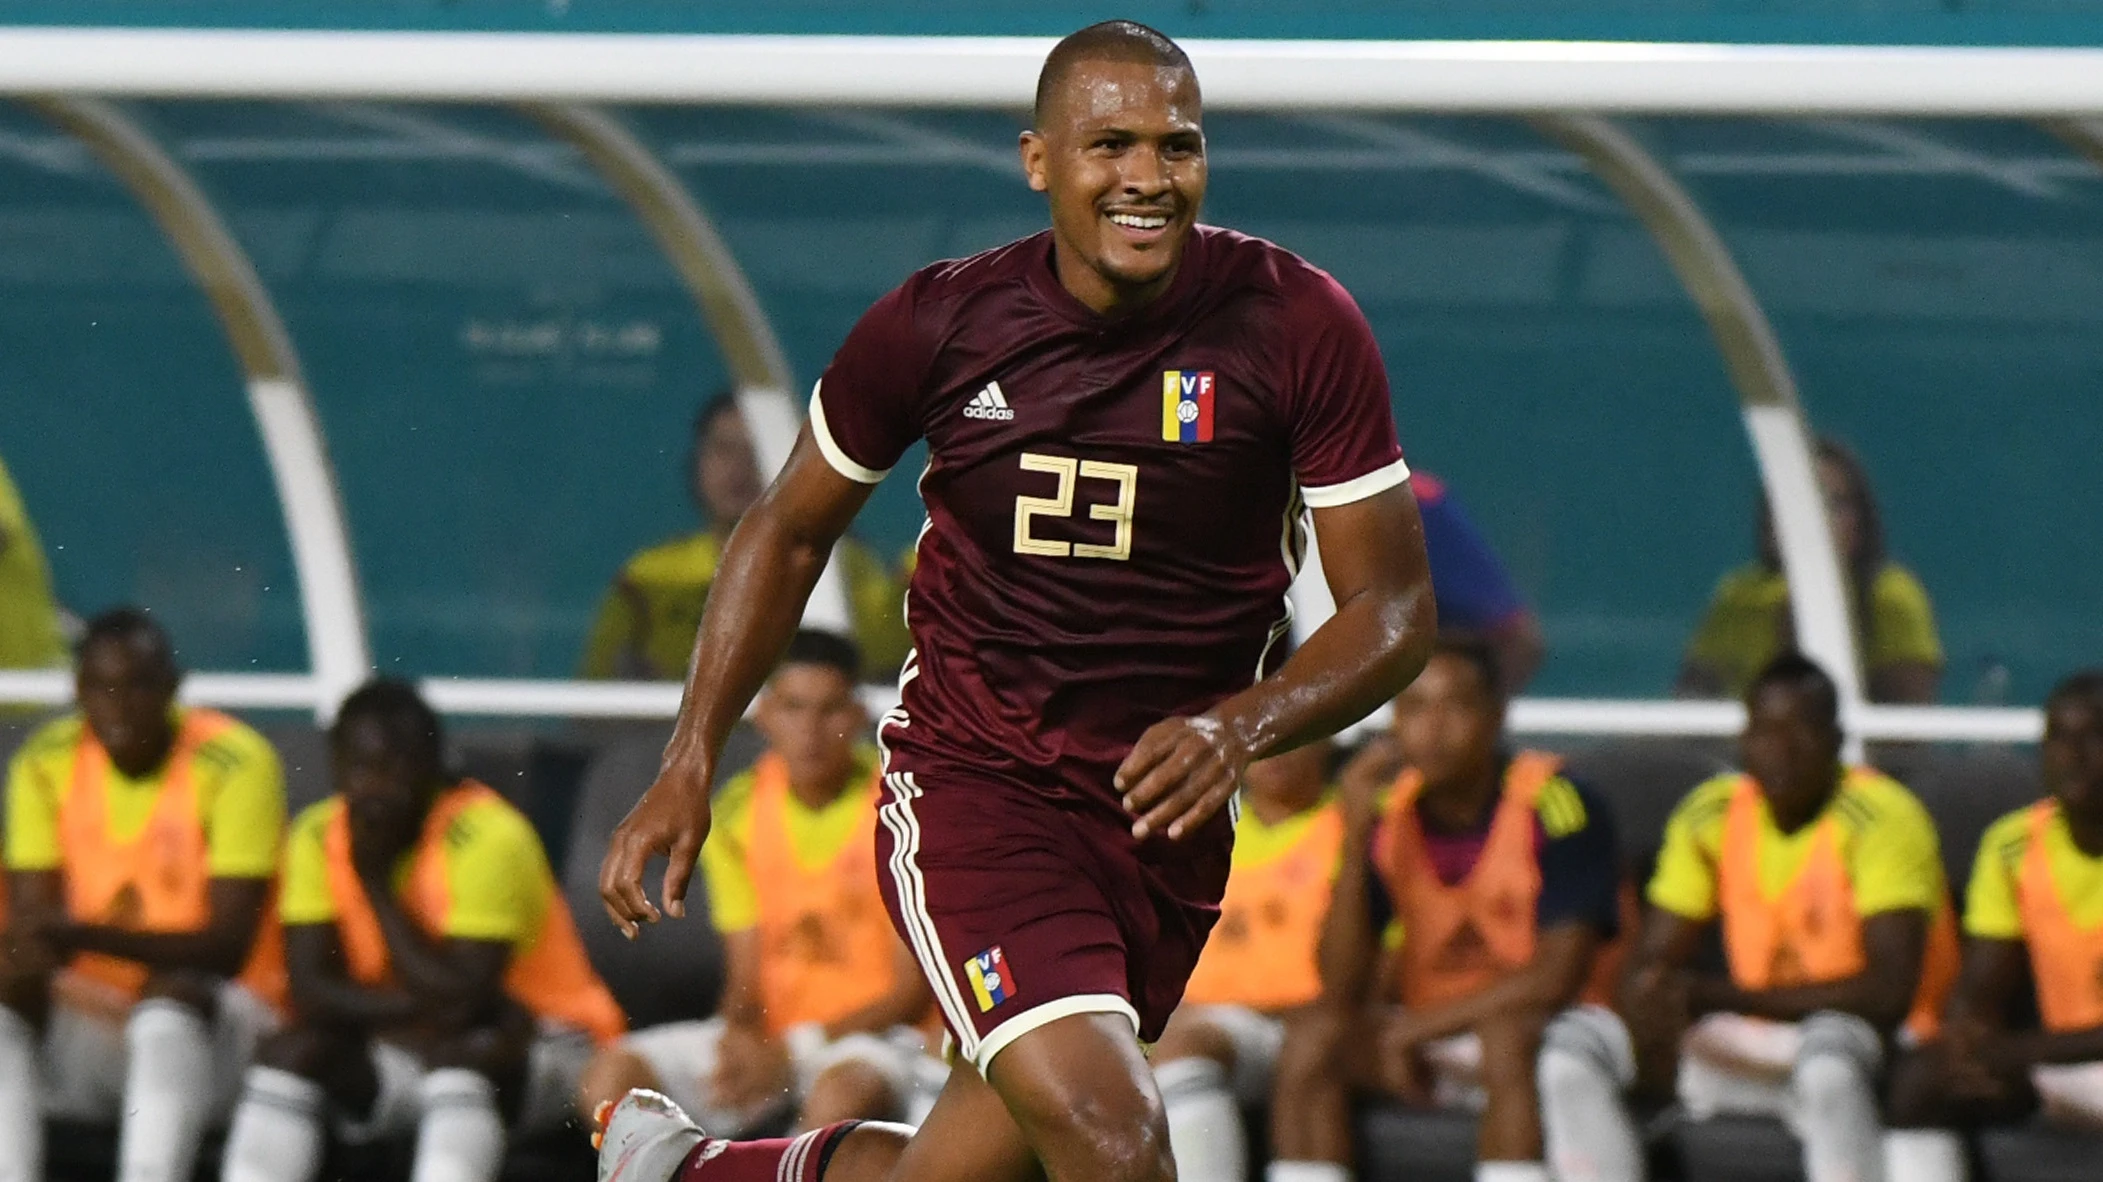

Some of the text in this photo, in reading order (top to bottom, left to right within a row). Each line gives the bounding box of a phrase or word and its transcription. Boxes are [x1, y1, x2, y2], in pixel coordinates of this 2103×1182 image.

[1167, 376, 1211, 394] FVF
[963, 405, 1014, 420] adidas
[1013, 453, 1138, 560] 23
